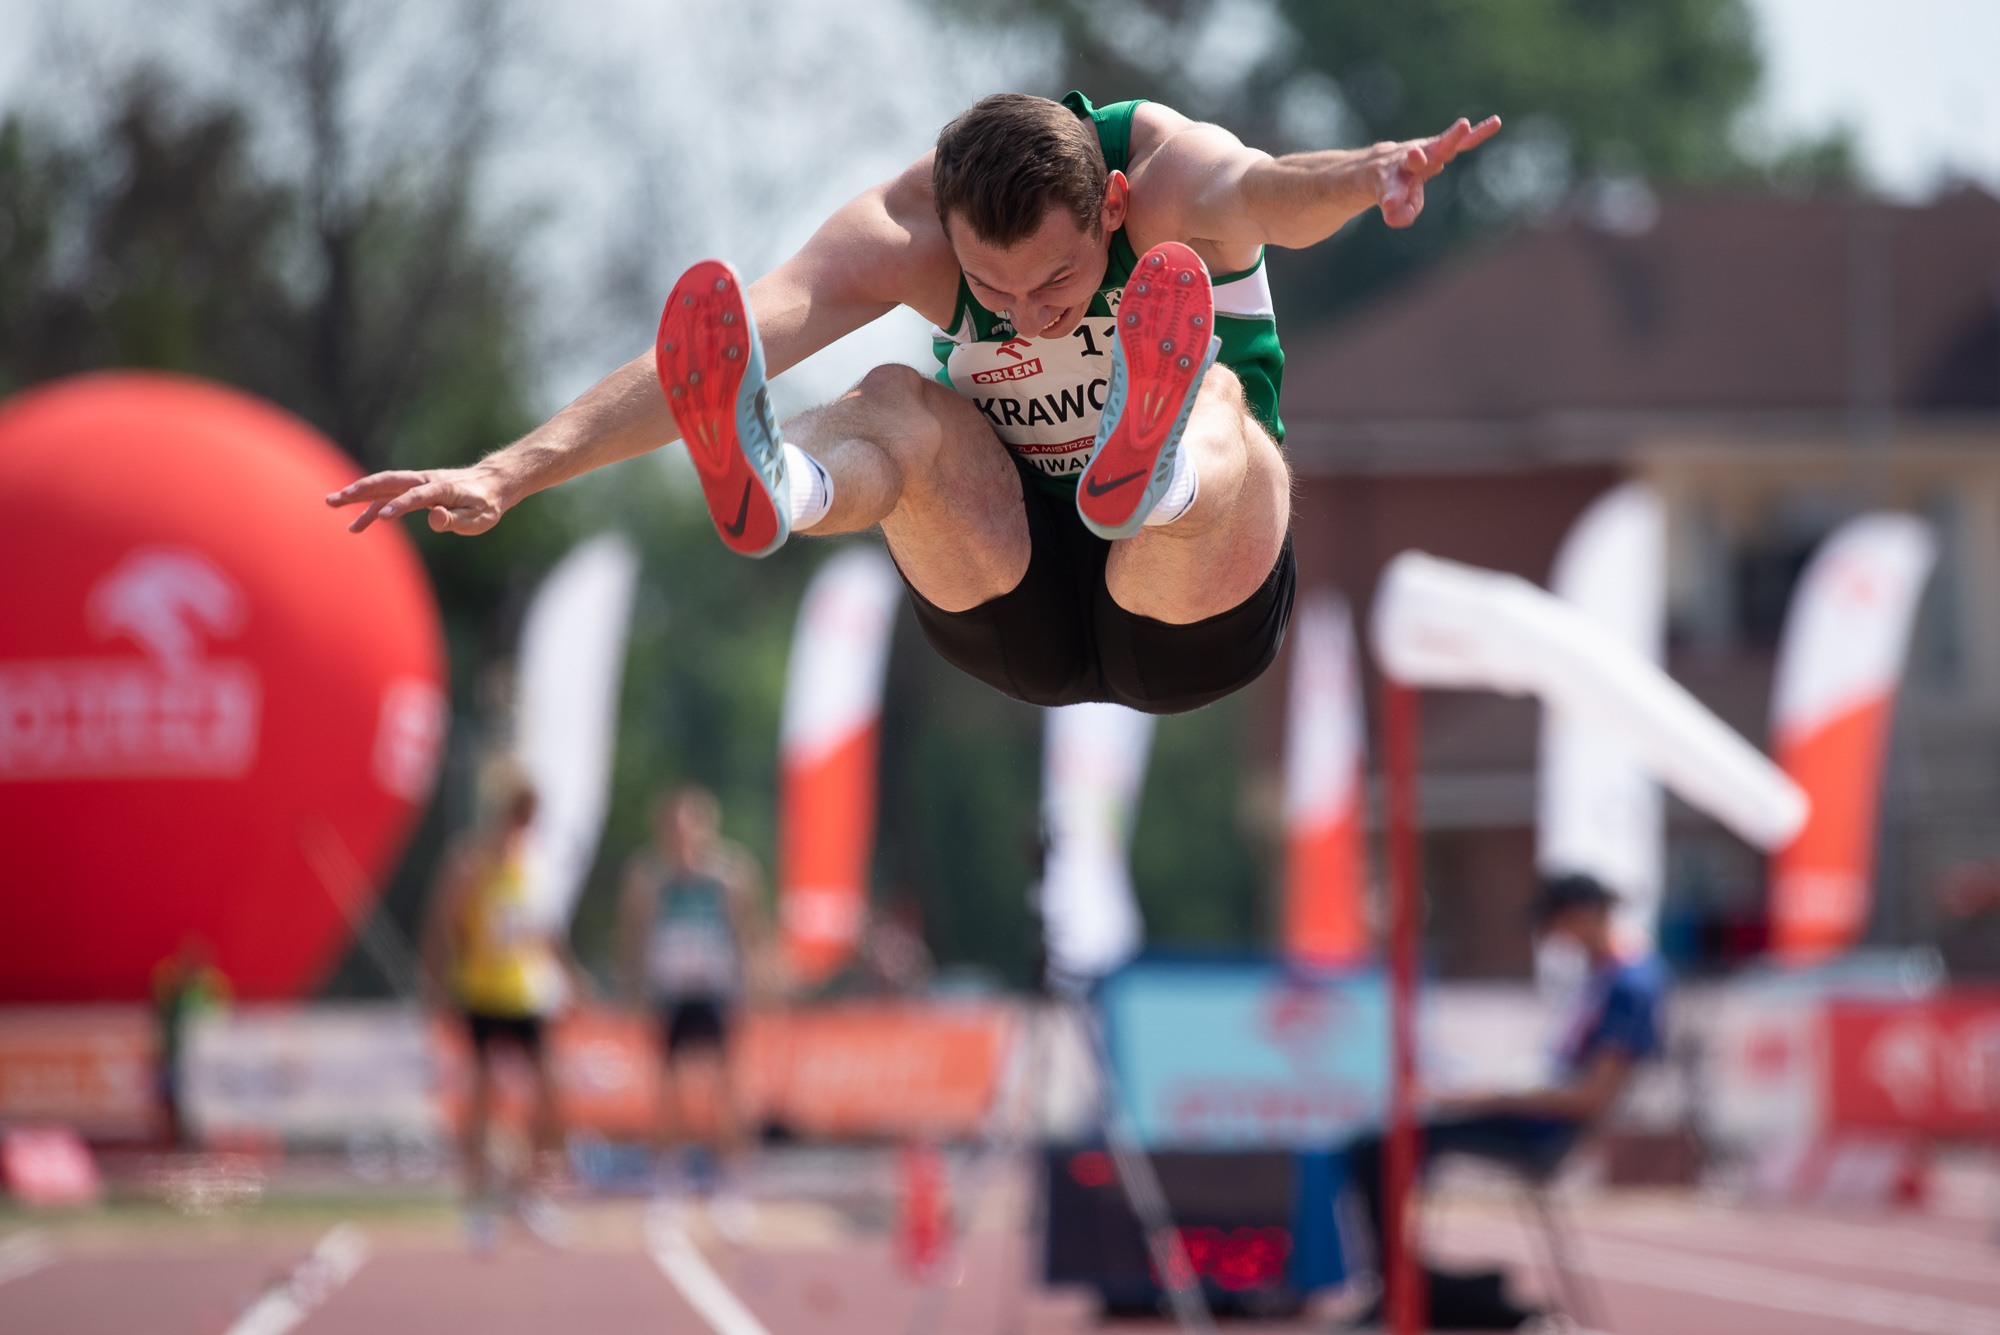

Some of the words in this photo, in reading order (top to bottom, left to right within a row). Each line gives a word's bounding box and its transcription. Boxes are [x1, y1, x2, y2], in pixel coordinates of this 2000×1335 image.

[1072, 325, 1115, 357] 1
[976, 360, 1039, 383] ORLEN
[972, 378, 1110, 426] KRAWC
